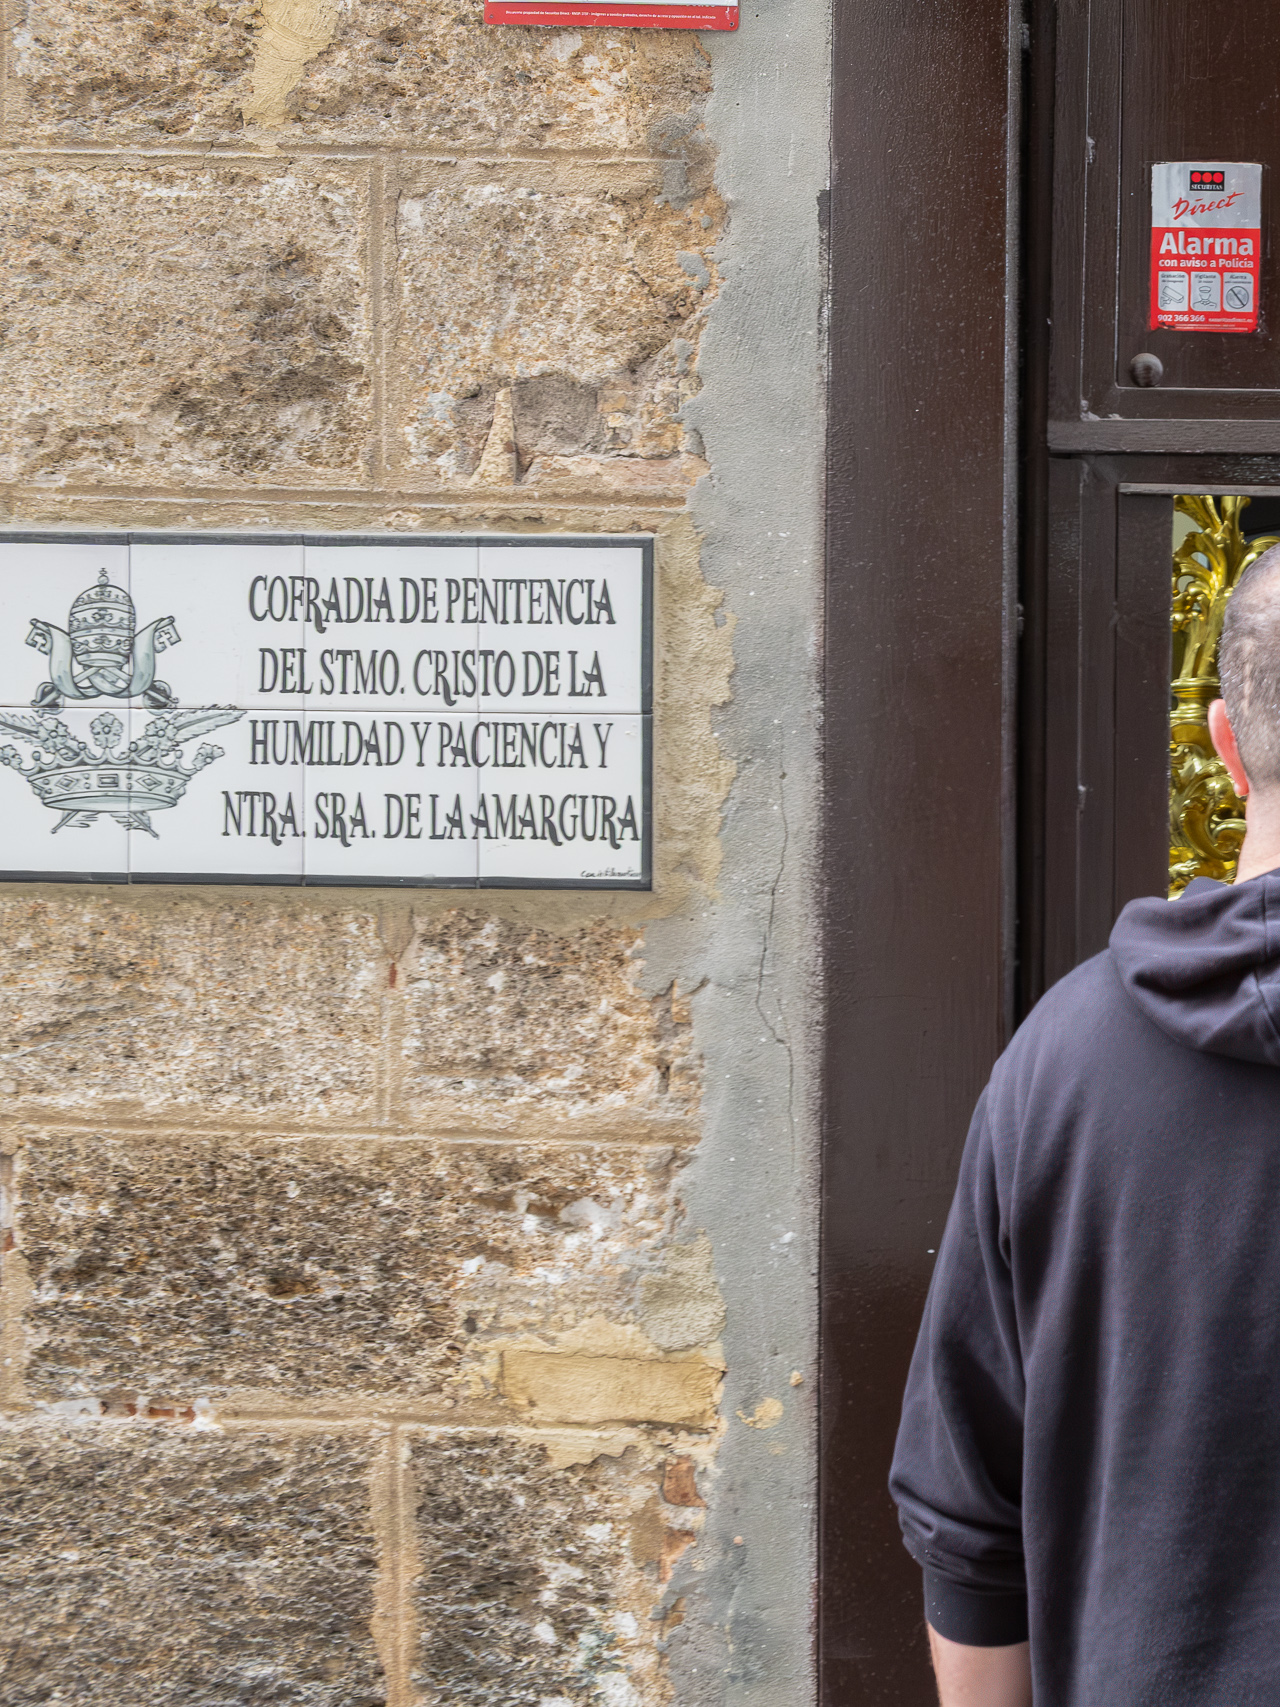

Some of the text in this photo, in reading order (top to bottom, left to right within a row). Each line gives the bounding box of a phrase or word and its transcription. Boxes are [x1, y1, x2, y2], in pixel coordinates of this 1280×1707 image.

[1171, 191, 1245, 220] Direct
[1159, 231, 1254, 256] Alarma
[1159, 257, 1254, 268] con aviso a Policía
[1157, 314, 1173, 322] 902
[1173, 314, 1189, 322] 366
[1189, 314, 1206, 322] 366
[249, 575, 617, 633] COFRADIA DE PENITENCIA
[258, 647, 607, 706] DEL STMO. CRISTO DE LA
[249, 719, 614, 769] HUMILDAD Y PACIENCIA Y
[221, 790, 641, 850] NTRA. SRA. DE LA AMARGURA
